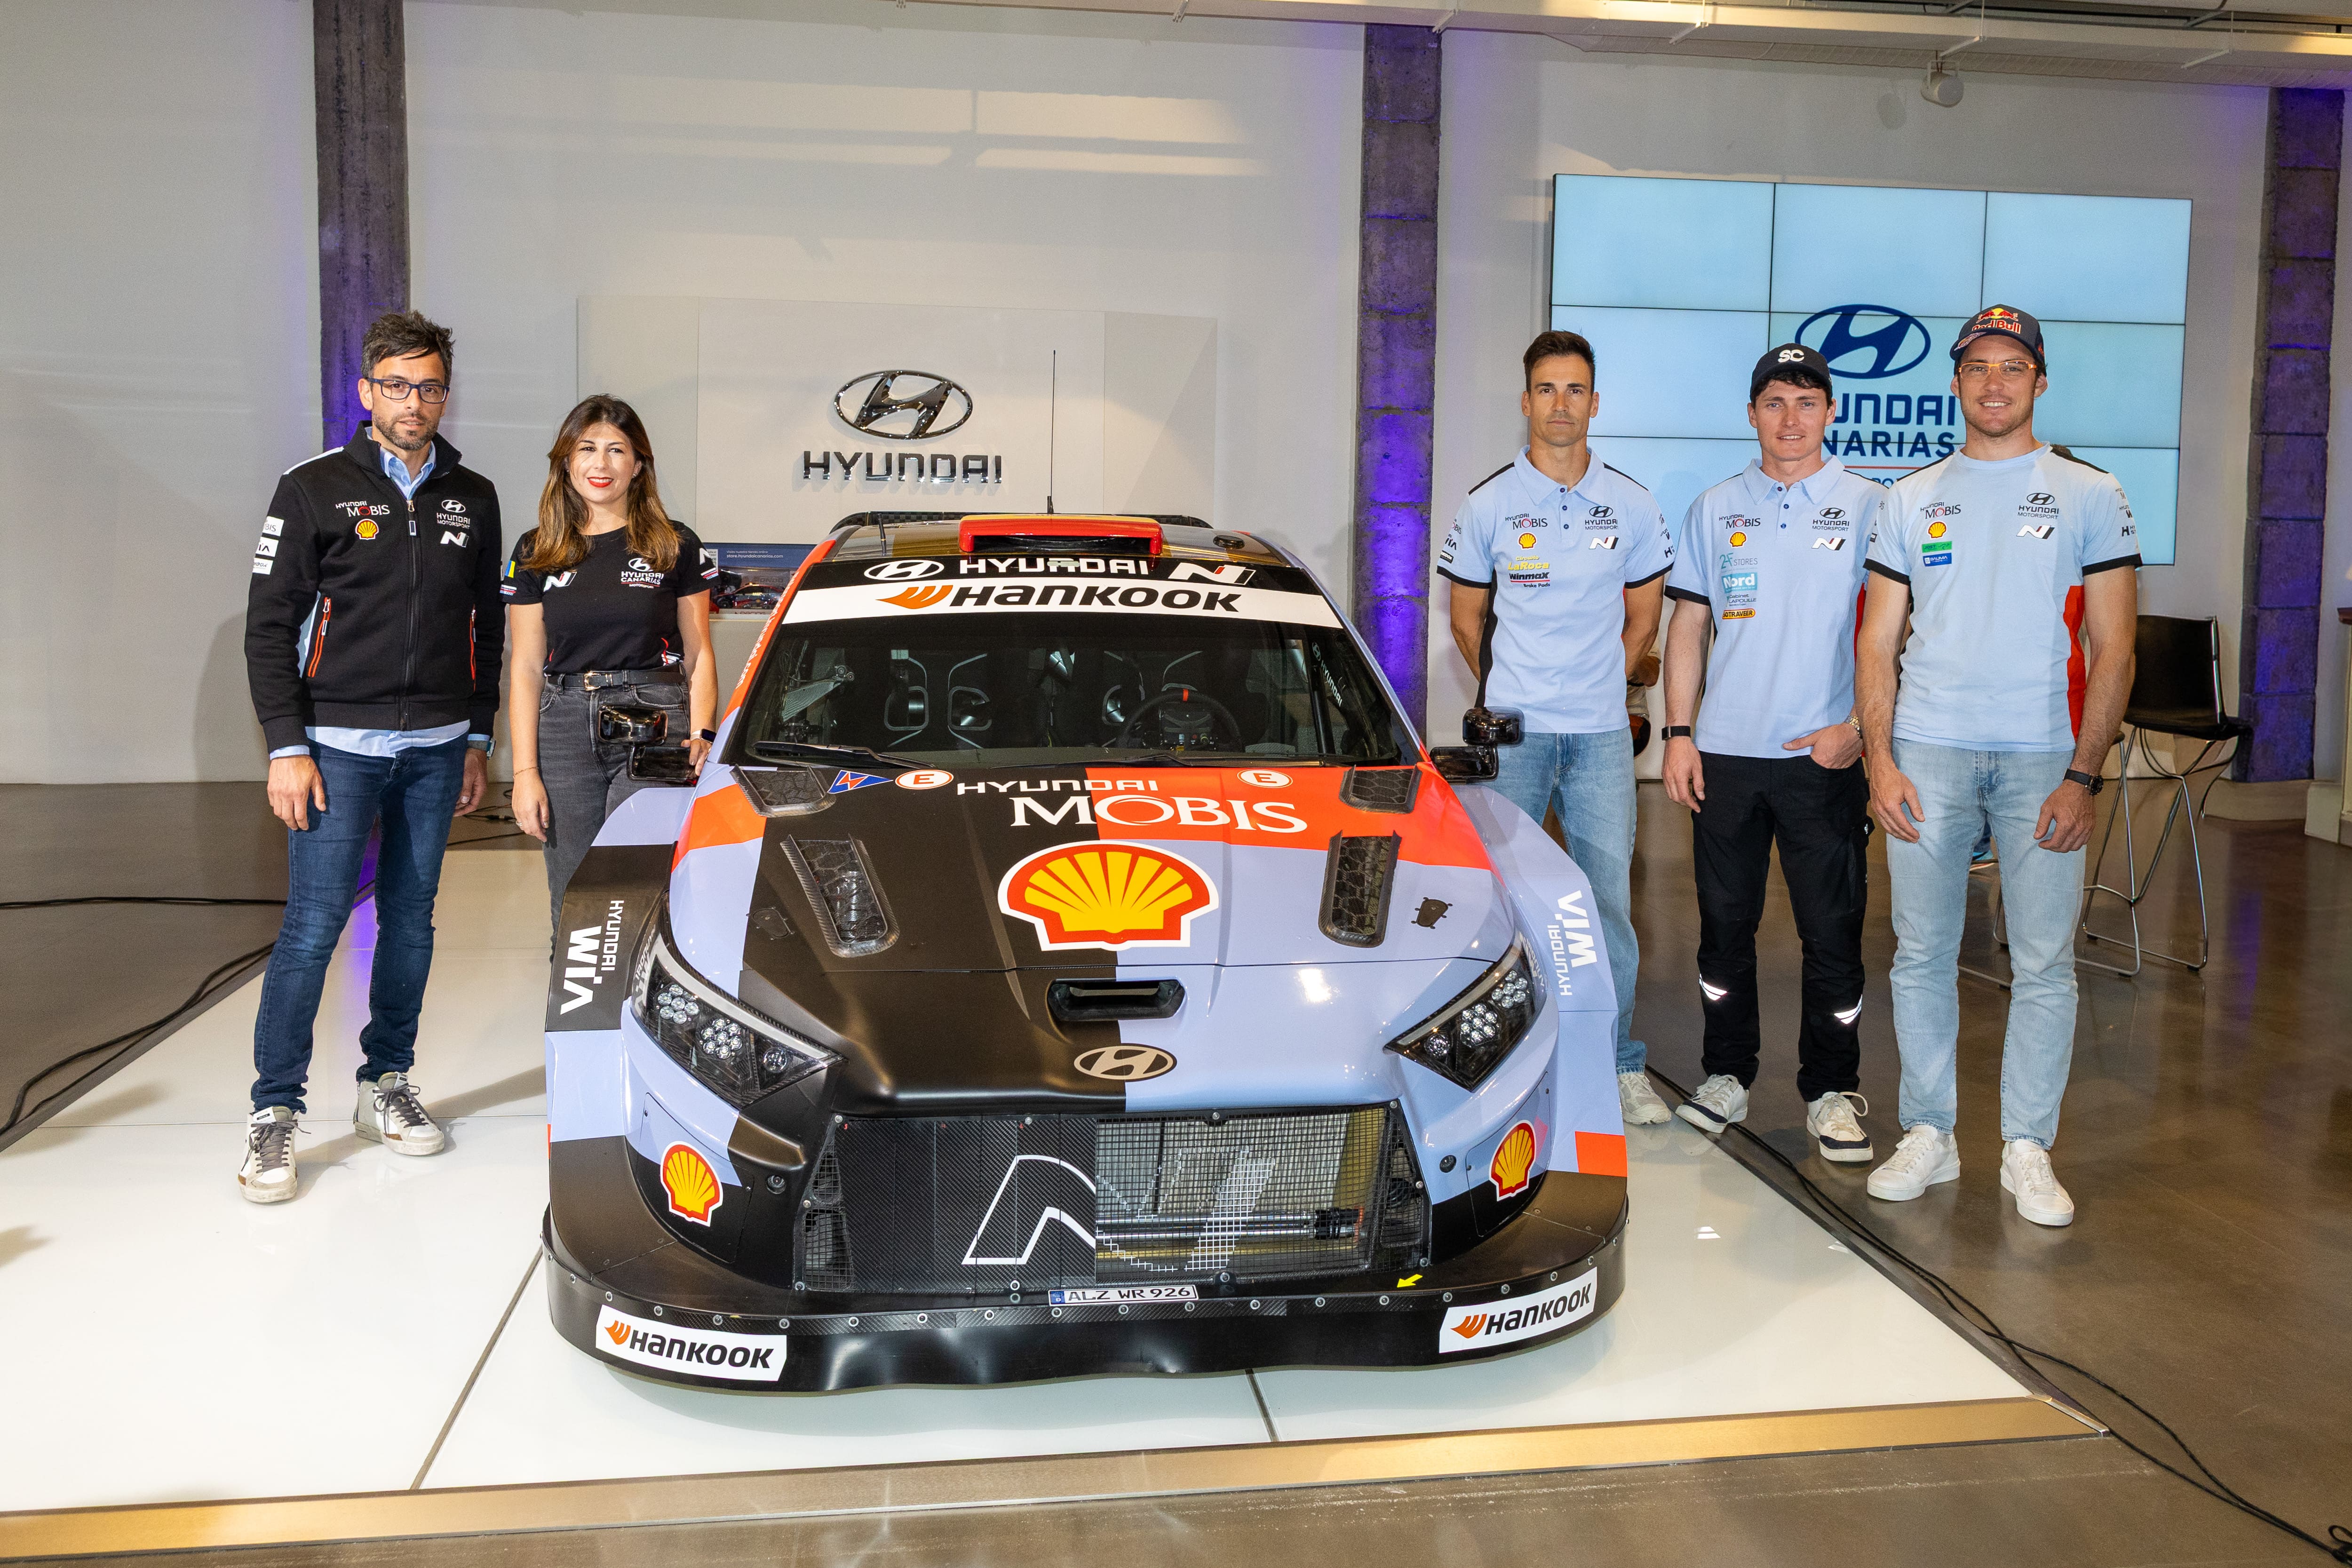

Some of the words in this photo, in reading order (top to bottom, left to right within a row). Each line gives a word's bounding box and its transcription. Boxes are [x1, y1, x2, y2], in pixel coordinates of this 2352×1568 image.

[1996, 319, 2021, 334] Bull
[1778, 349, 1804, 362] SC
[1833, 393, 1955, 426] UNDAI
[1823, 430, 1955, 458] NARIAS
[803, 451, 1002, 484] HYUNDAI
[335, 501, 367, 509] HYUNDAI
[347, 505, 390, 517] MOBIS
[1925, 504, 1961, 519] MOBIS
[2018, 505, 2059, 514] HYUNDAI
[437, 512, 470, 525] HYUNDAI
[437, 519, 470, 529] MOTORSPORT
[1513, 518, 1548, 530] MOBIS
[1725, 518, 1761, 529] MOBIS
[960, 558, 1149, 574] HYUNDAI
[1723, 573, 1755, 589] Nord
[1321, 660, 1343, 707] HYUNDAI
[958, 779, 1158, 795] HYUNDAI
[1009, 795, 1307, 833] MOBIS
[601, 900, 624, 971] HYUNDAI
[1548, 925, 1572, 996] HYUNDAI
[1068, 1290, 1110, 1301] ALZ
[1118, 1289, 1145, 1298] WR
[1150, 1287, 1190, 1298] 926
